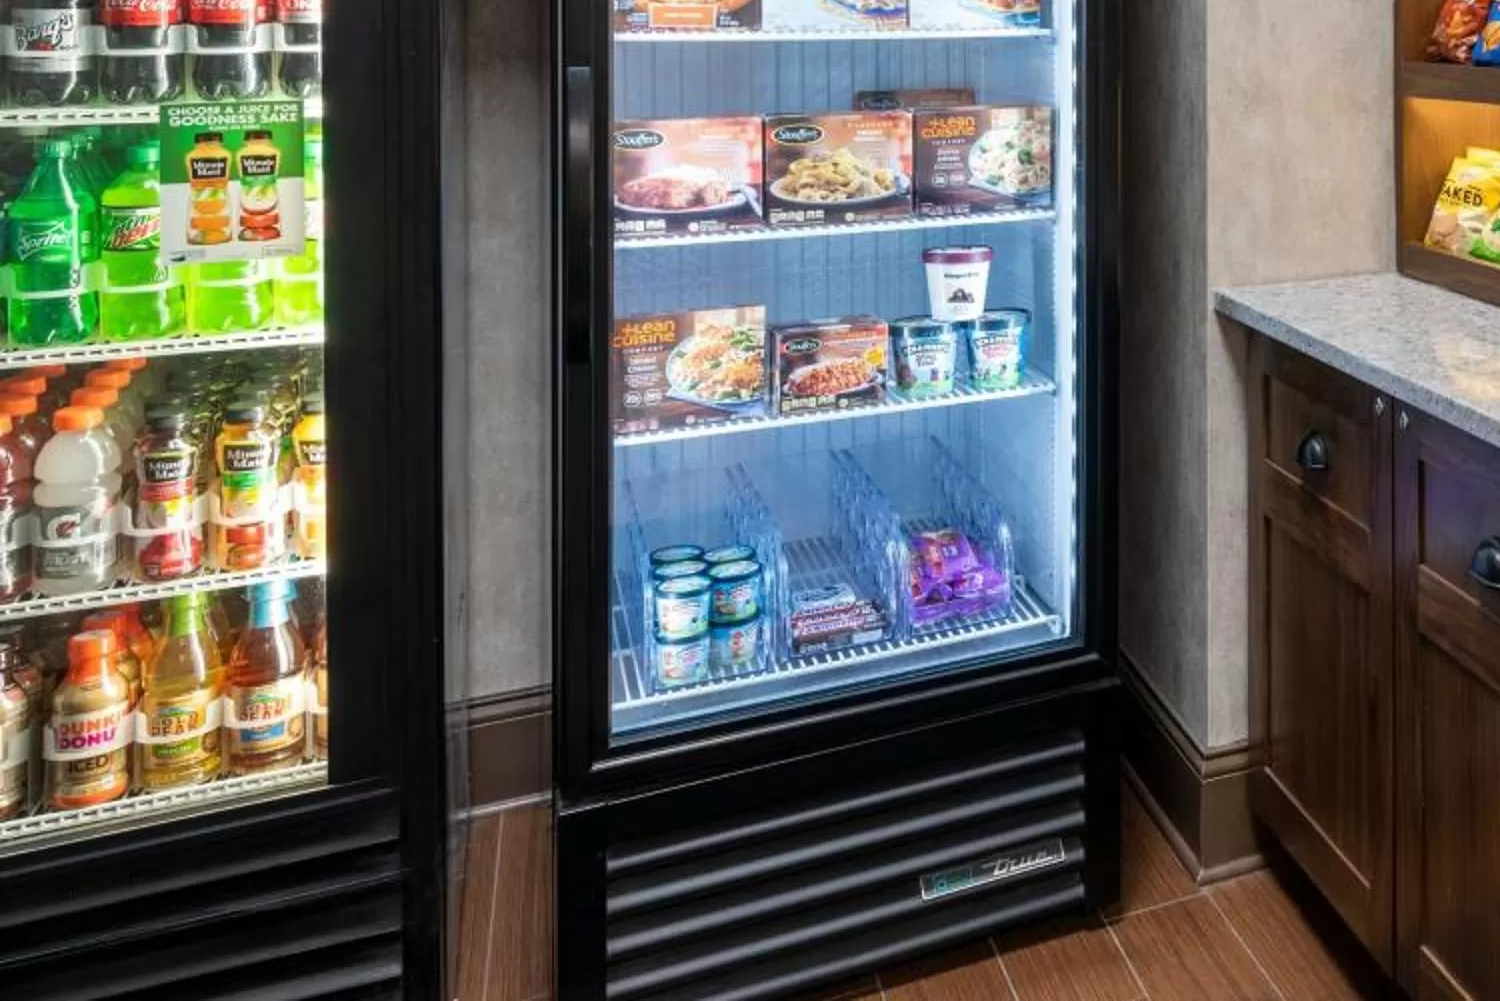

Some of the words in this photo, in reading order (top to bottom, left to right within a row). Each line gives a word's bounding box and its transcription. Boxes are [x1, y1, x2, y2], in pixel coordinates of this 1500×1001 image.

[168, 105, 221, 117] CHOOSE
[237, 103, 271, 113] JUICE
[273, 103, 298, 112] FOR
[169, 114, 257, 127] GOODNESS
[260, 112, 298, 123] SAKE
[1440, 184, 1483, 207] AKED
[19, 231, 67, 249] Sprite
[60, 726, 118, 749] DONU
